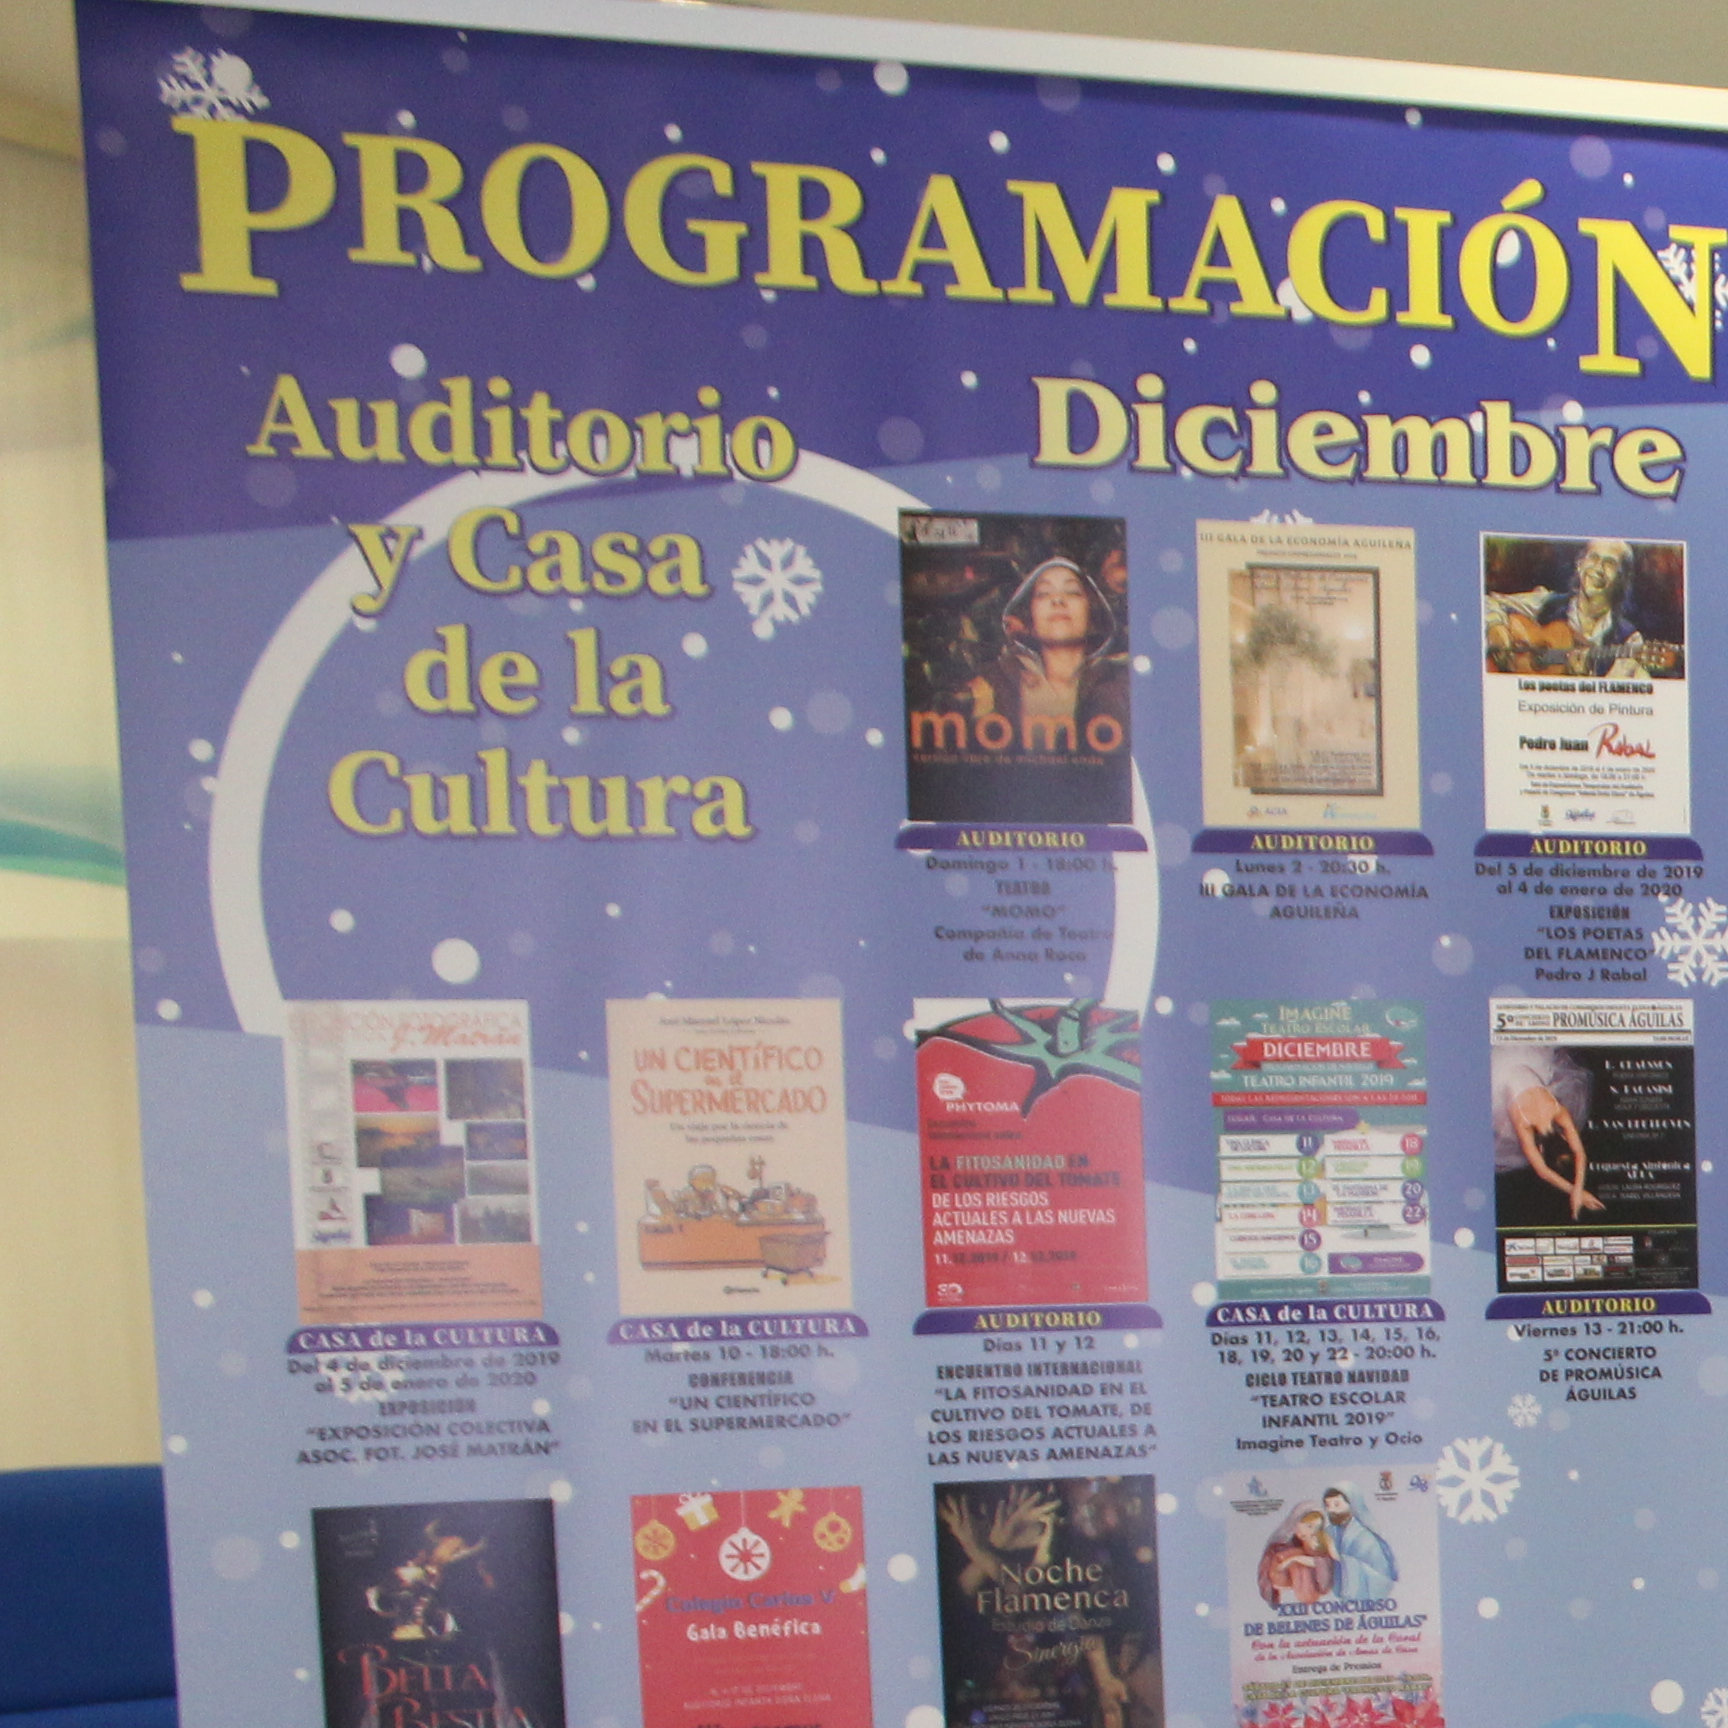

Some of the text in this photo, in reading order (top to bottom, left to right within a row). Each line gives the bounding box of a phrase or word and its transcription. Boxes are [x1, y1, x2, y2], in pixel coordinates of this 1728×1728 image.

[170, 113, 1728, 382] PROGRAMACIÓN
[246, 373, 799, 481] Auditorio
[1031, 372, 1688, 502] Diciembre
[348, 506, 713, 617] y Casa
[404, 623, 672, 720] de la
[910, 706, 1124, 750] momo
[327, 746, 755, 840] Cultura
[1250, 832, 1375, 853] AUDITORIO
[1496, 879, 1684, 900] al 4 de enero de 2020
[1262, 1041, 1372, 1060] DICIEMBRE
[933, 1229, 1016, 1247] AMENAZAS
[1542, 1297, 1657, 1318] AUDITORIO
[1538, 1365, 1662, 1383] DE PROMÚSICA
[1565, 1385, 1638, 1403] ÁGUILAS
[999, 1558, 1103, 1586] Noche
[975, 1585, 1130, 1616] Flamenca
[685, 1617, 821, 1642] Gala Benéfica
